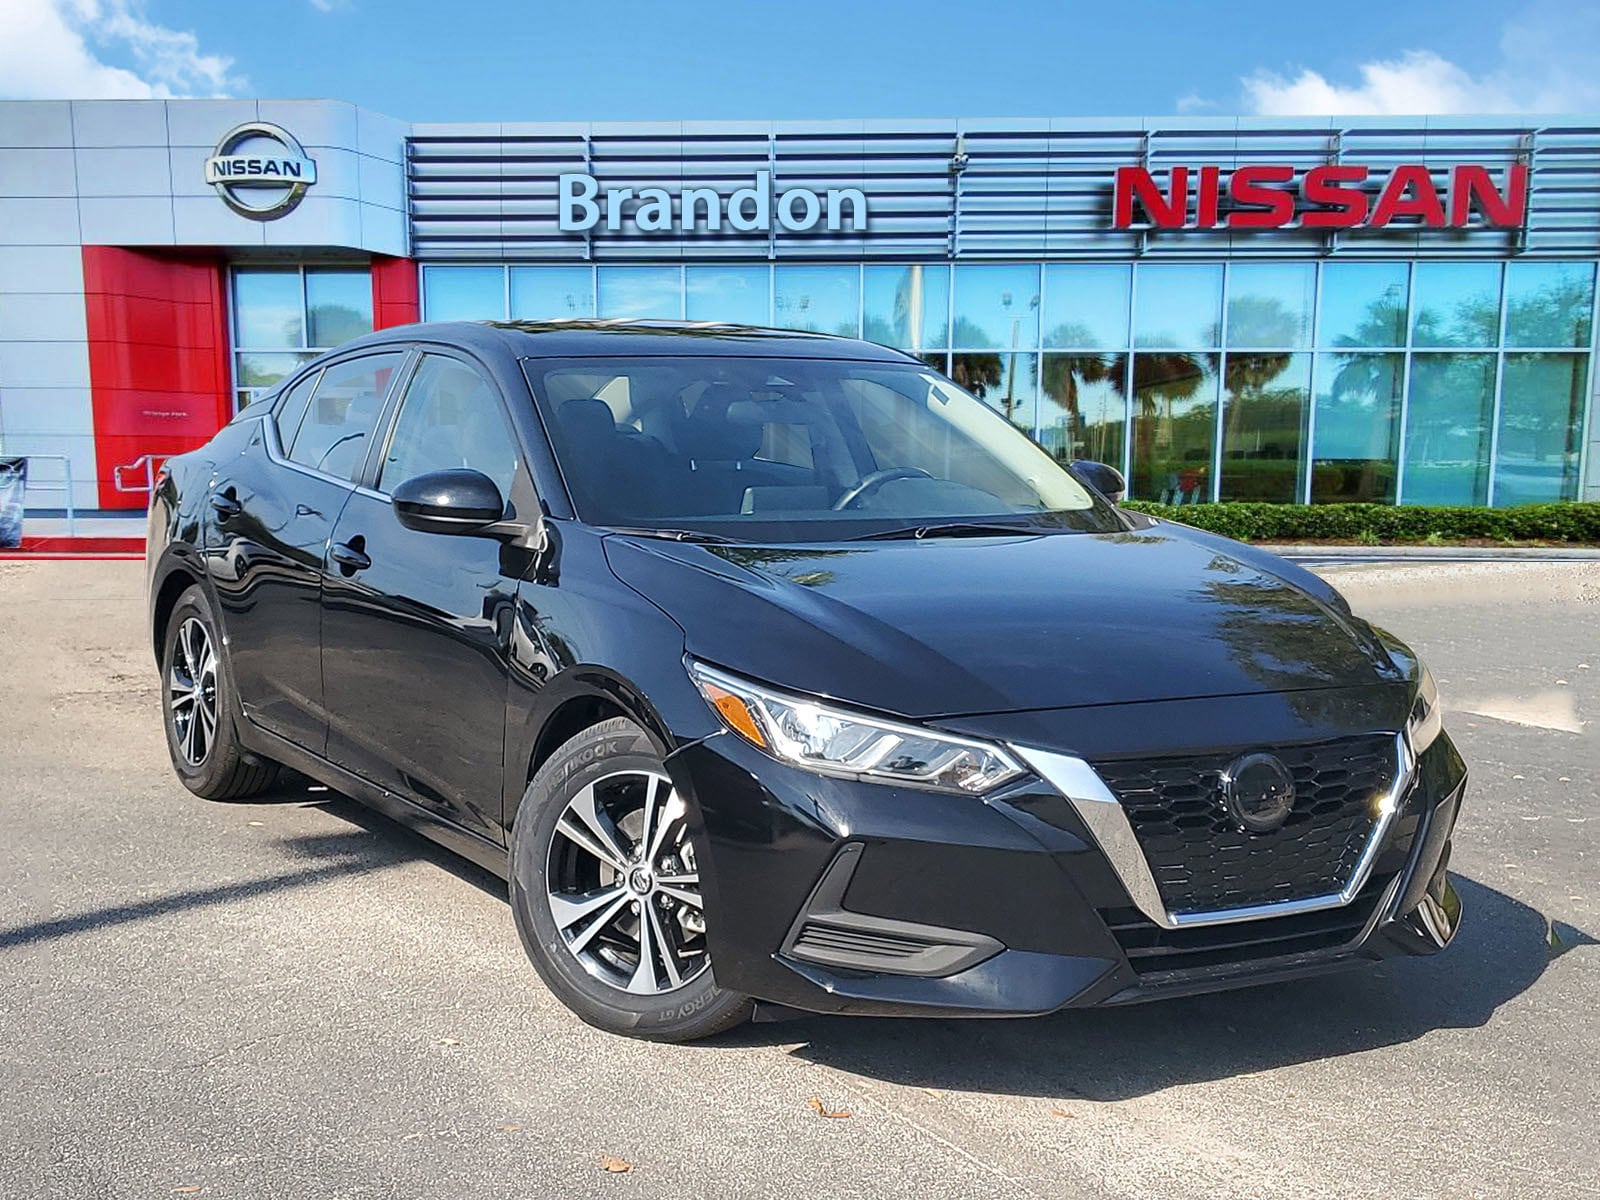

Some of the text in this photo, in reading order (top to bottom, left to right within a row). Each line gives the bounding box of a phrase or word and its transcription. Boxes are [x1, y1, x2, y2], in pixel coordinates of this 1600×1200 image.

[213, 159, 301, 177] NISSAN
[1113, 165, 1529, 229] NISSAN
[559, 170, 867, 231] Brandon
